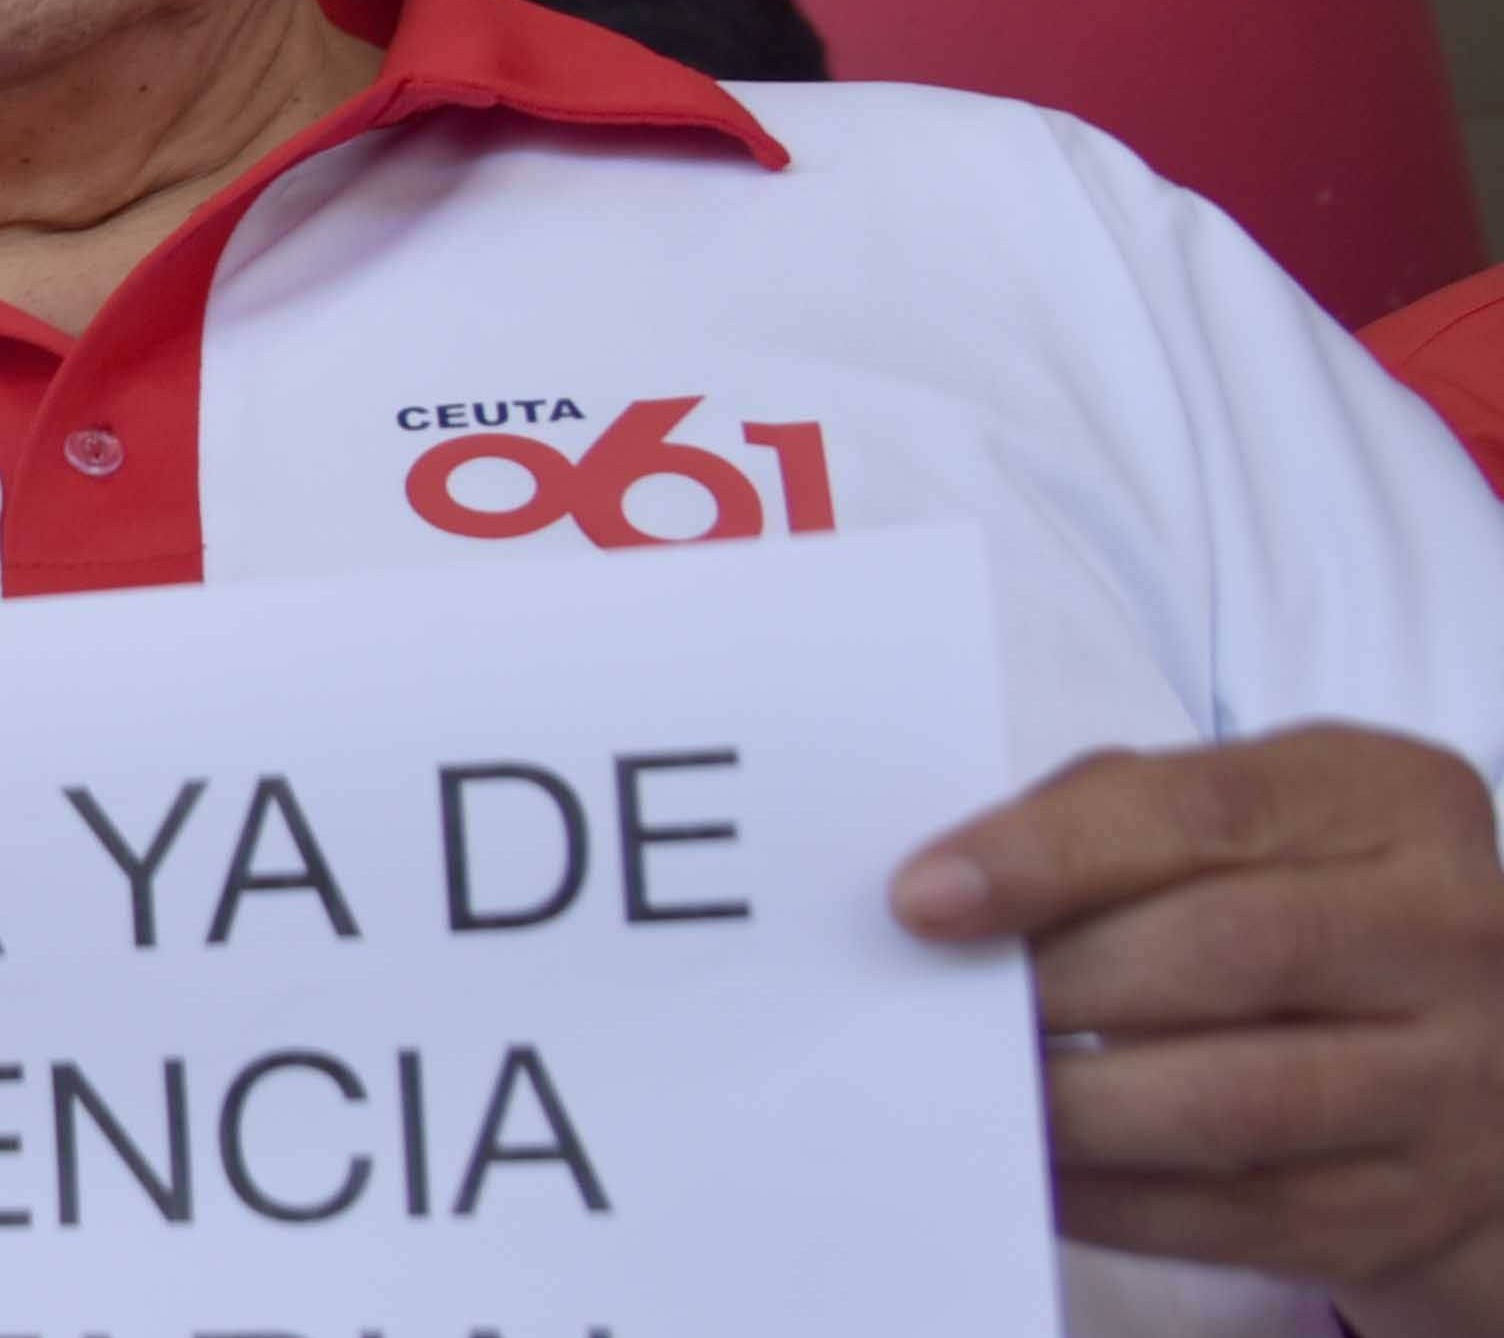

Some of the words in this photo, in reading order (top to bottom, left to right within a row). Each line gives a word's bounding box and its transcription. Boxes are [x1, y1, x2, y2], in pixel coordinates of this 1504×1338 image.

[396, 397, 586, 432] CEUTA
[403, 395, 837, 553] 061
[61, 775, 361, 952] YA
[438, 747, 754, 935] DE
